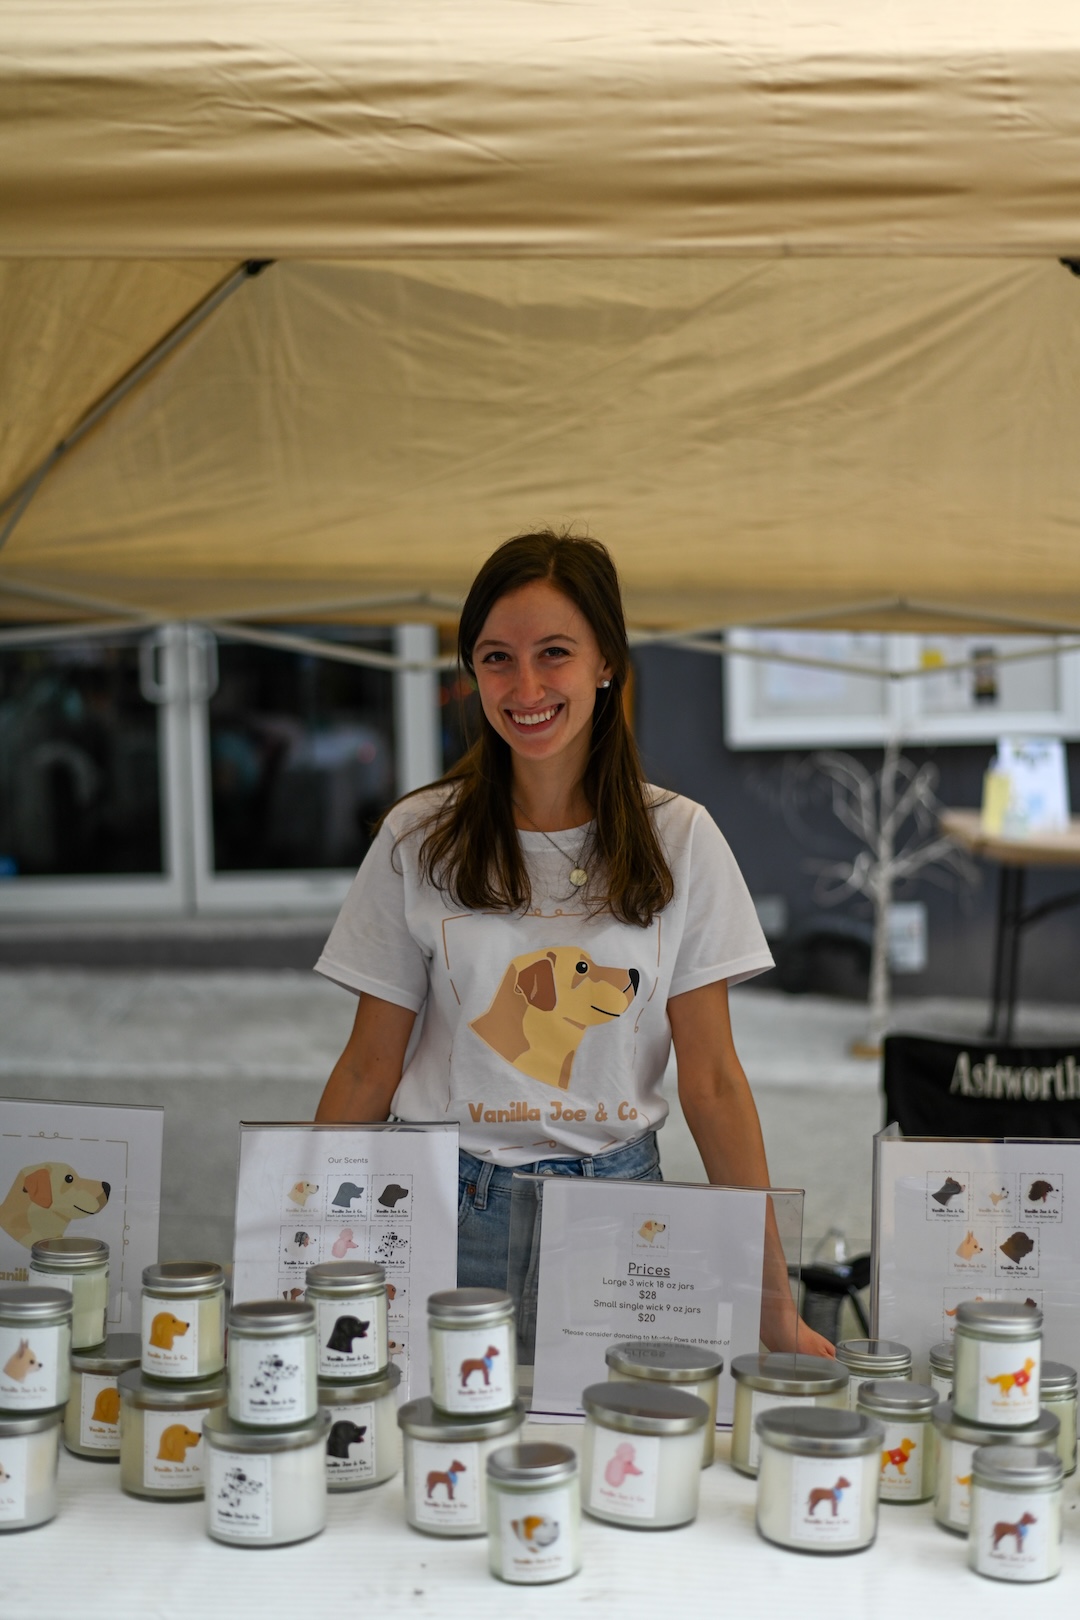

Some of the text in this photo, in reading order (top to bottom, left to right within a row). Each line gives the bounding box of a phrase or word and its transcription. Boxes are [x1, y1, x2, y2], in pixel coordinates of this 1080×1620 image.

[949, 1051, 1080, 1101] Ashworth
[468, 1101, 638, 1123] Vanilla Joe & Co
[0, 1267, 29, 1282] anill
[628, 1262, 670, 1278] Prices
[602, 1277, 627, 1287] Large
[636, 1280, 654, 1288] wick
[678, 1282, 694, 1291] jars
[639, 1290, 656, 1300] $28
[594, 1300, 617, 1308] Small
[619, 1302, 644, 1311] single
[646, 1303, 663, 1311] wick
[684, 1306, 701, 1314] jars
[638, 1314, 656, 1323] $20
[585, 1330, 612, 1338] consider
[614, 1332, 641, 1340] donating
